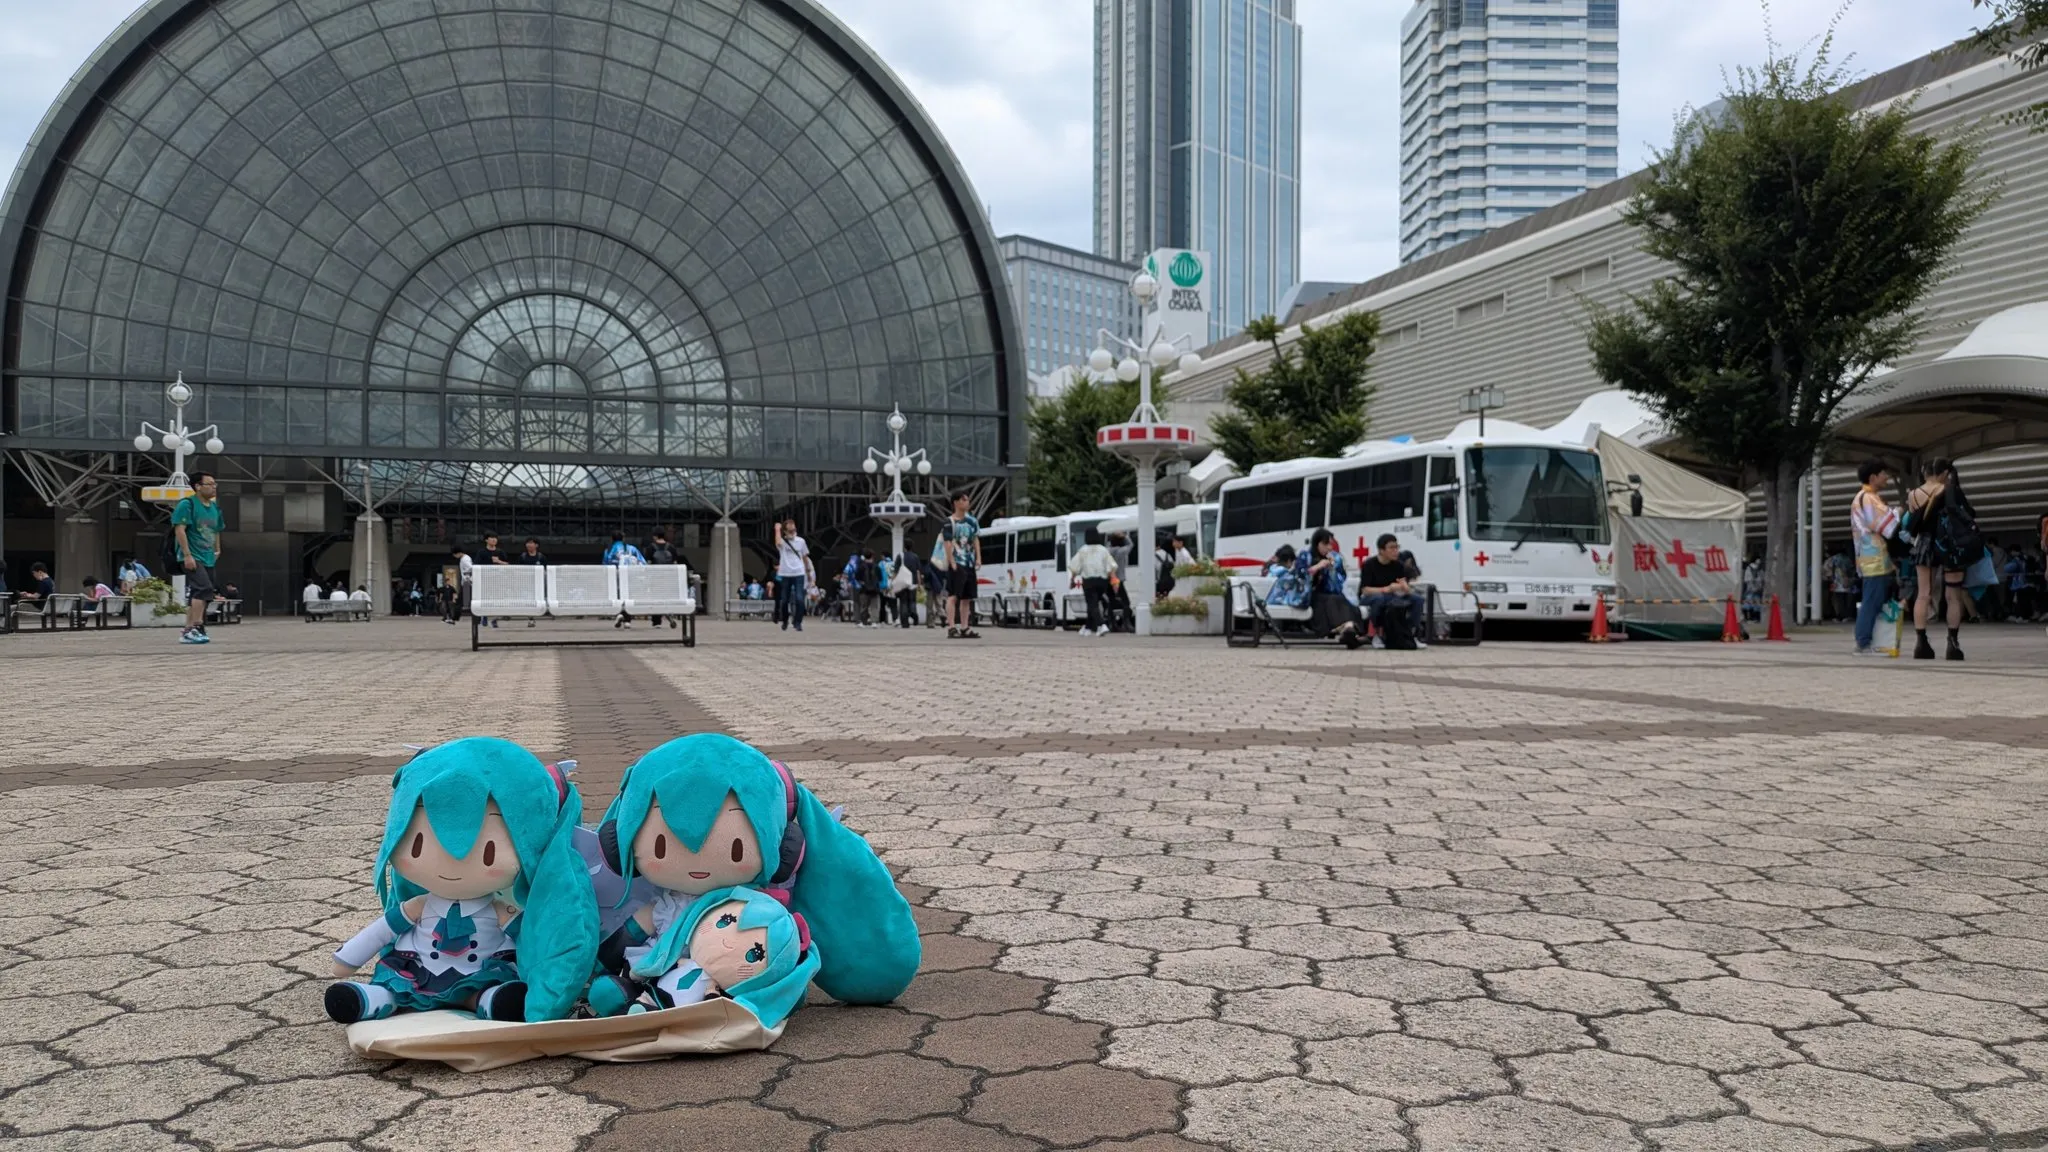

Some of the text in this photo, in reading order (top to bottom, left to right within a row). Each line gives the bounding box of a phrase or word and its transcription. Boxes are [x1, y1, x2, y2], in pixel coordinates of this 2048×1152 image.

[1172, 289, 1200, 300] INTEX
[1168, 299, 1203, 312] OSAKA
[1704, 544, 1730, 572] 血
